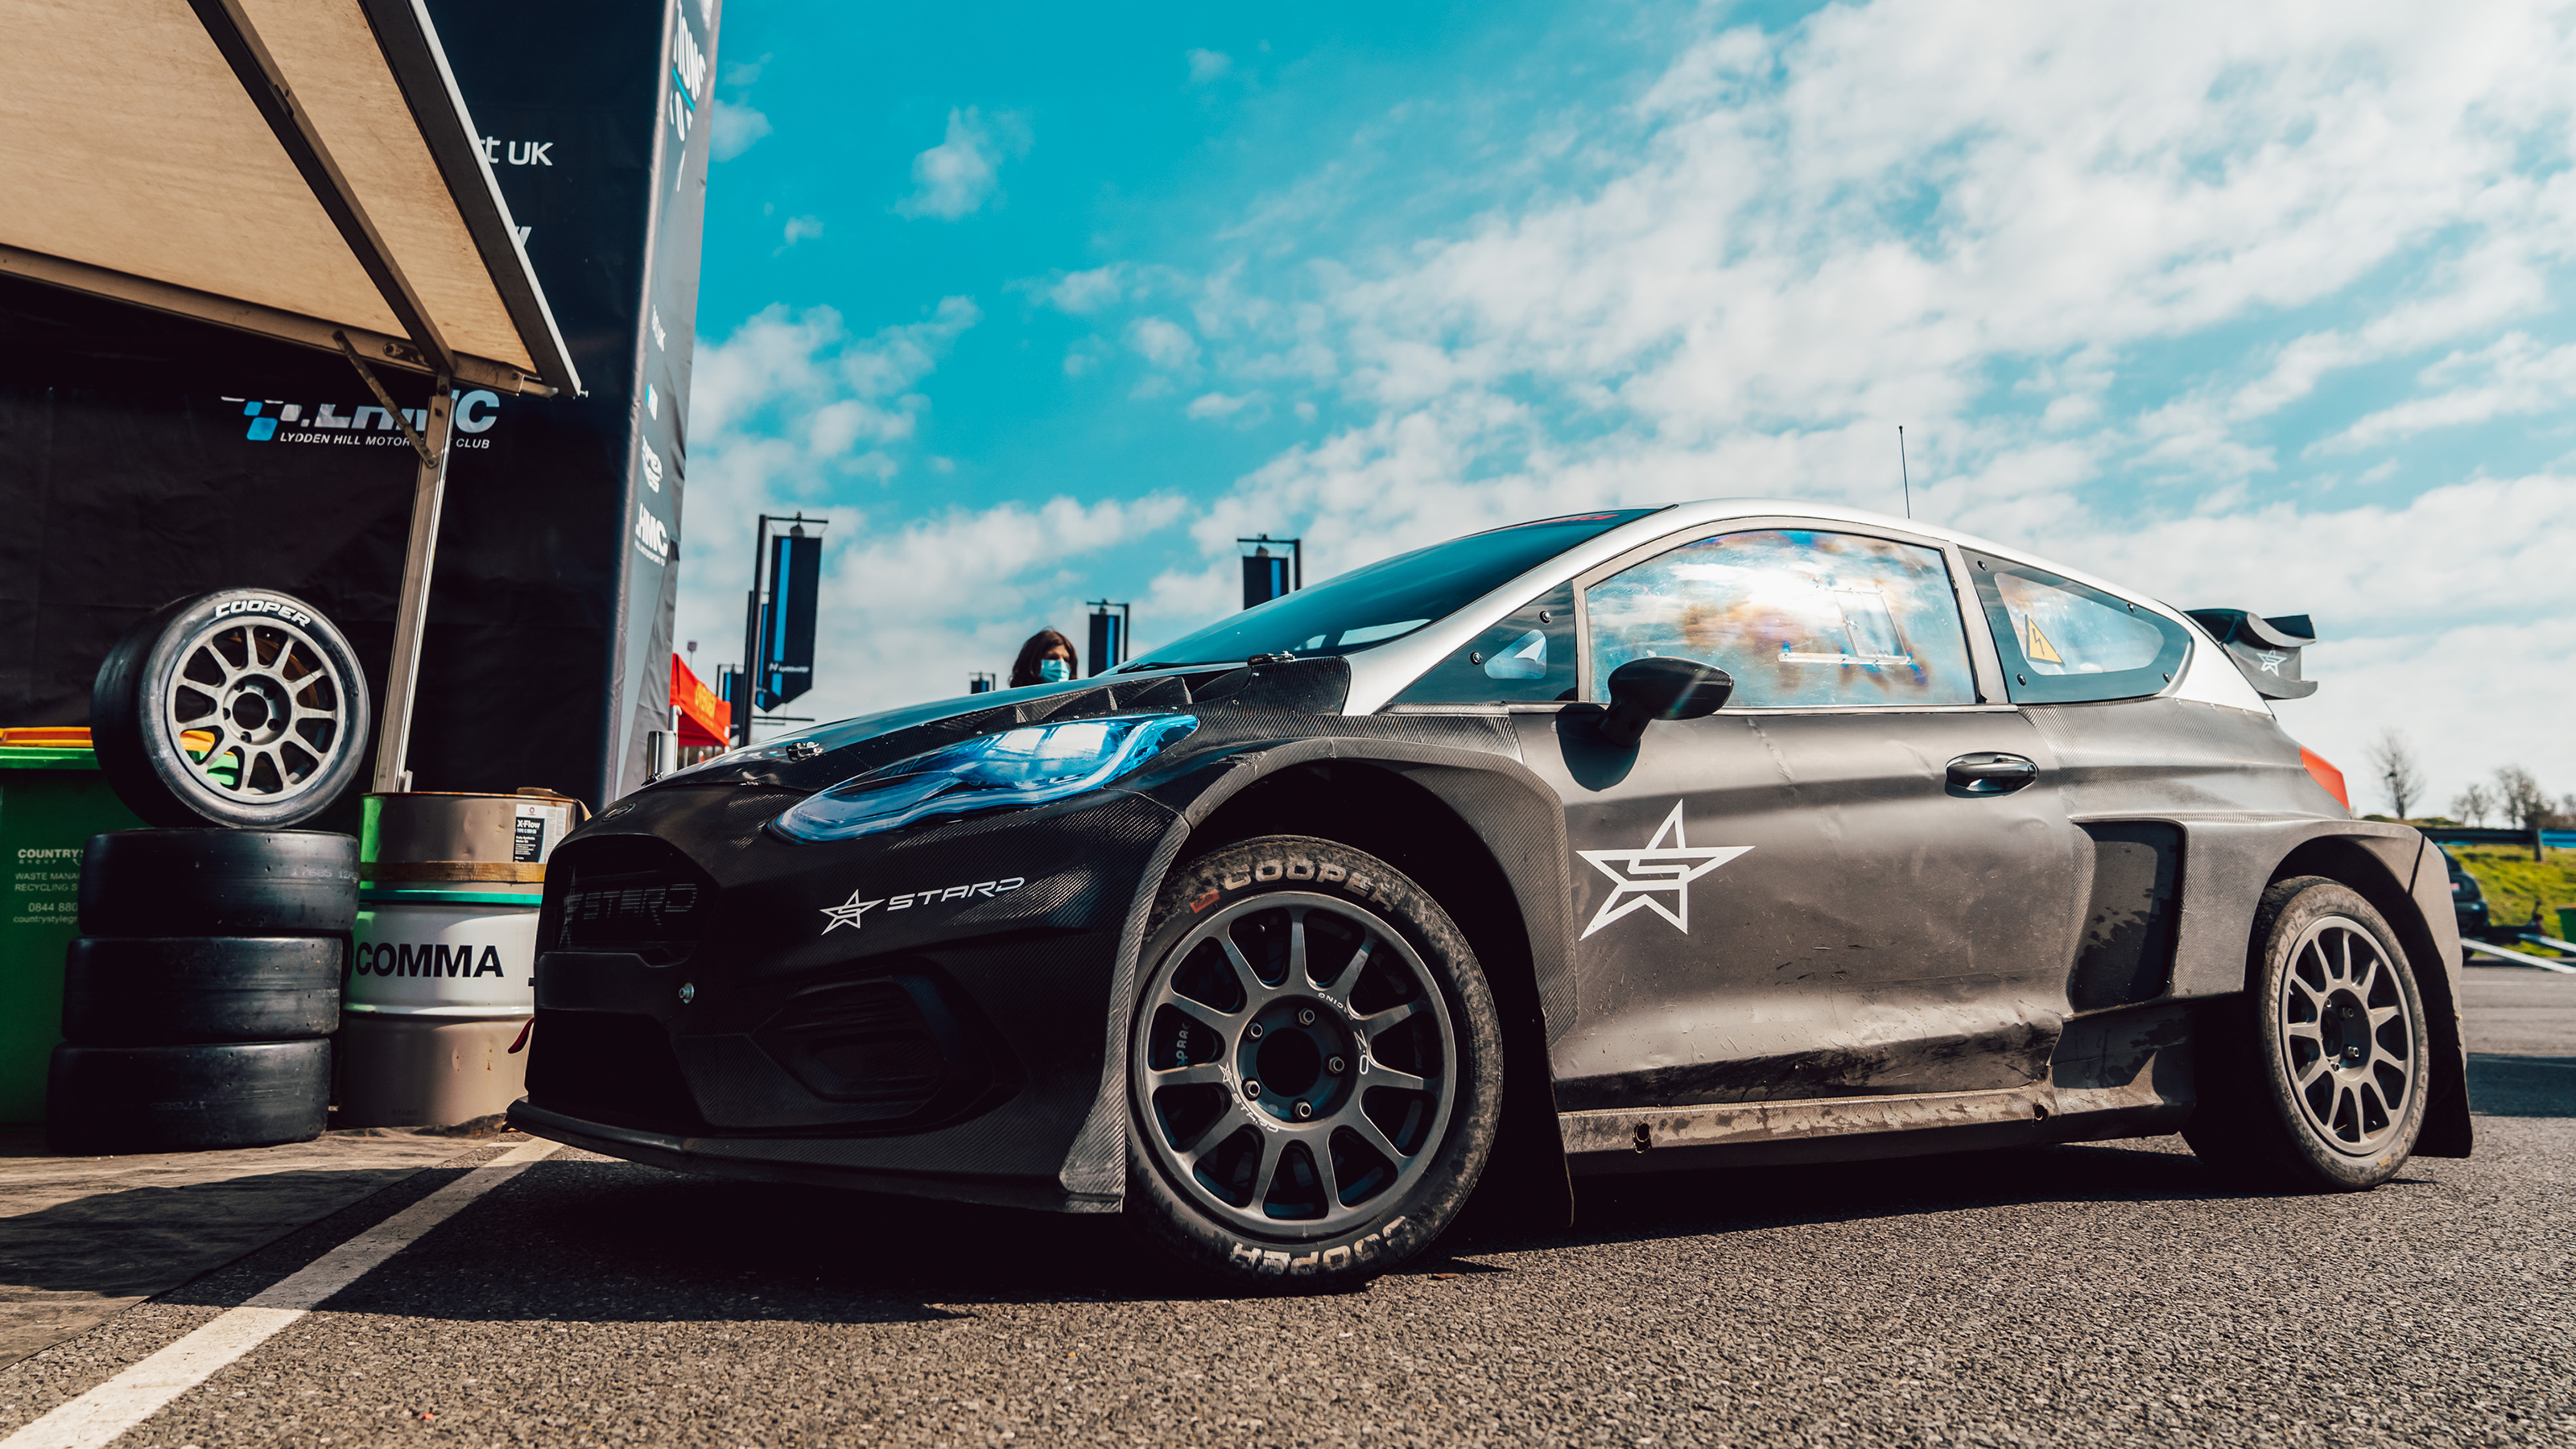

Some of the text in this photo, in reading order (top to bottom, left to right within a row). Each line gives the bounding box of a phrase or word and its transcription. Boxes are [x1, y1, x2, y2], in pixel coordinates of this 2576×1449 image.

[508, 141, 554, 166] UK
[280, 432, 330, 444] LYDDEN
[333, 435, 361, 445] HILL
[456, 438, 490, 449] CLUB
[215, 600, 312, 627] COOPER
[14, 884, 68, 892] RECYCLING
[887, 877, 1025, 911] STARD
[1224, 859, 1394, 913] COOPER
[28, 902, 54, 912] 0844
[356, 942, 504, 977] COMMA
[1232, 1092, 1279, 1133] STARD
